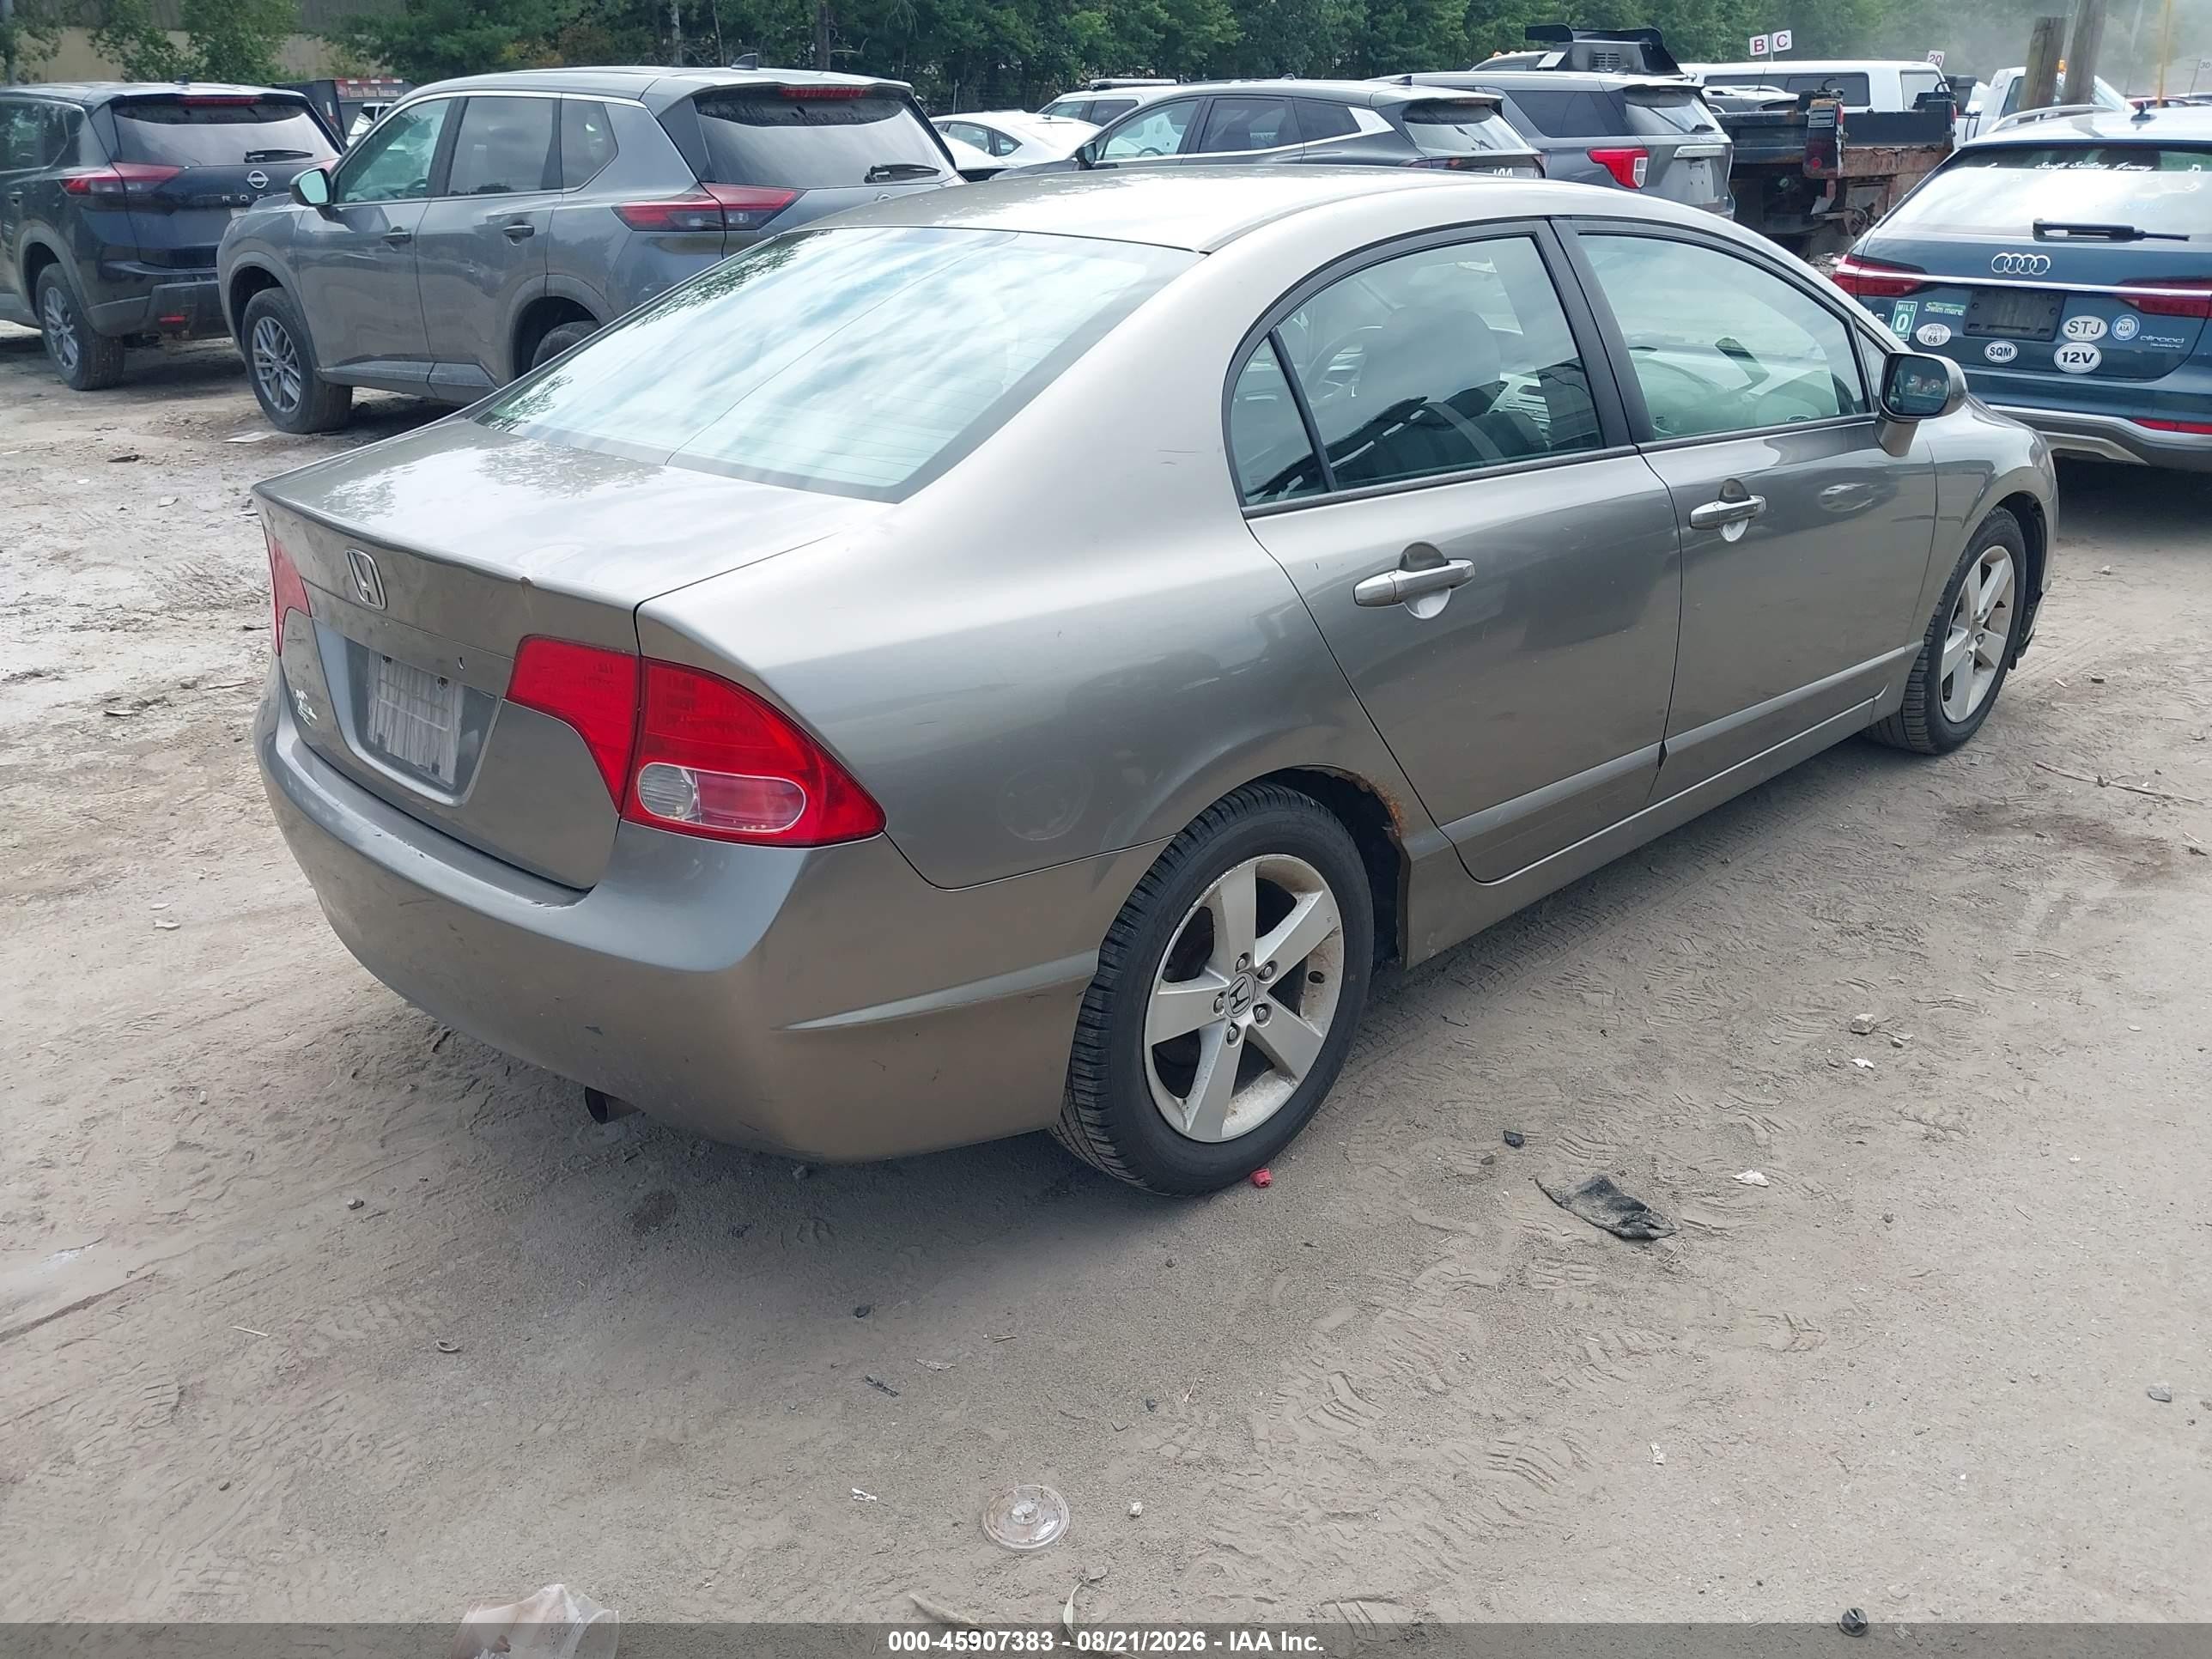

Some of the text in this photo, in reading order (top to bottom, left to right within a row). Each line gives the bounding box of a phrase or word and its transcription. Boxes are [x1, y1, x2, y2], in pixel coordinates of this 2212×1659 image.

[1753, 39, 1765, 52] B
[1777, 34, 1788, 47] C
[1929, 54, 1942, 63] 20
[1925, 301, 1964, 316] Swim more
[1896, 313, 1909, 331] 0
[2067, 320, 2101, 335] STJ
[2140, 335, 2185, 343] allroad
[1989, 347, 2012, 357] SQM
[2062, 351, 2095, 363] 12V
